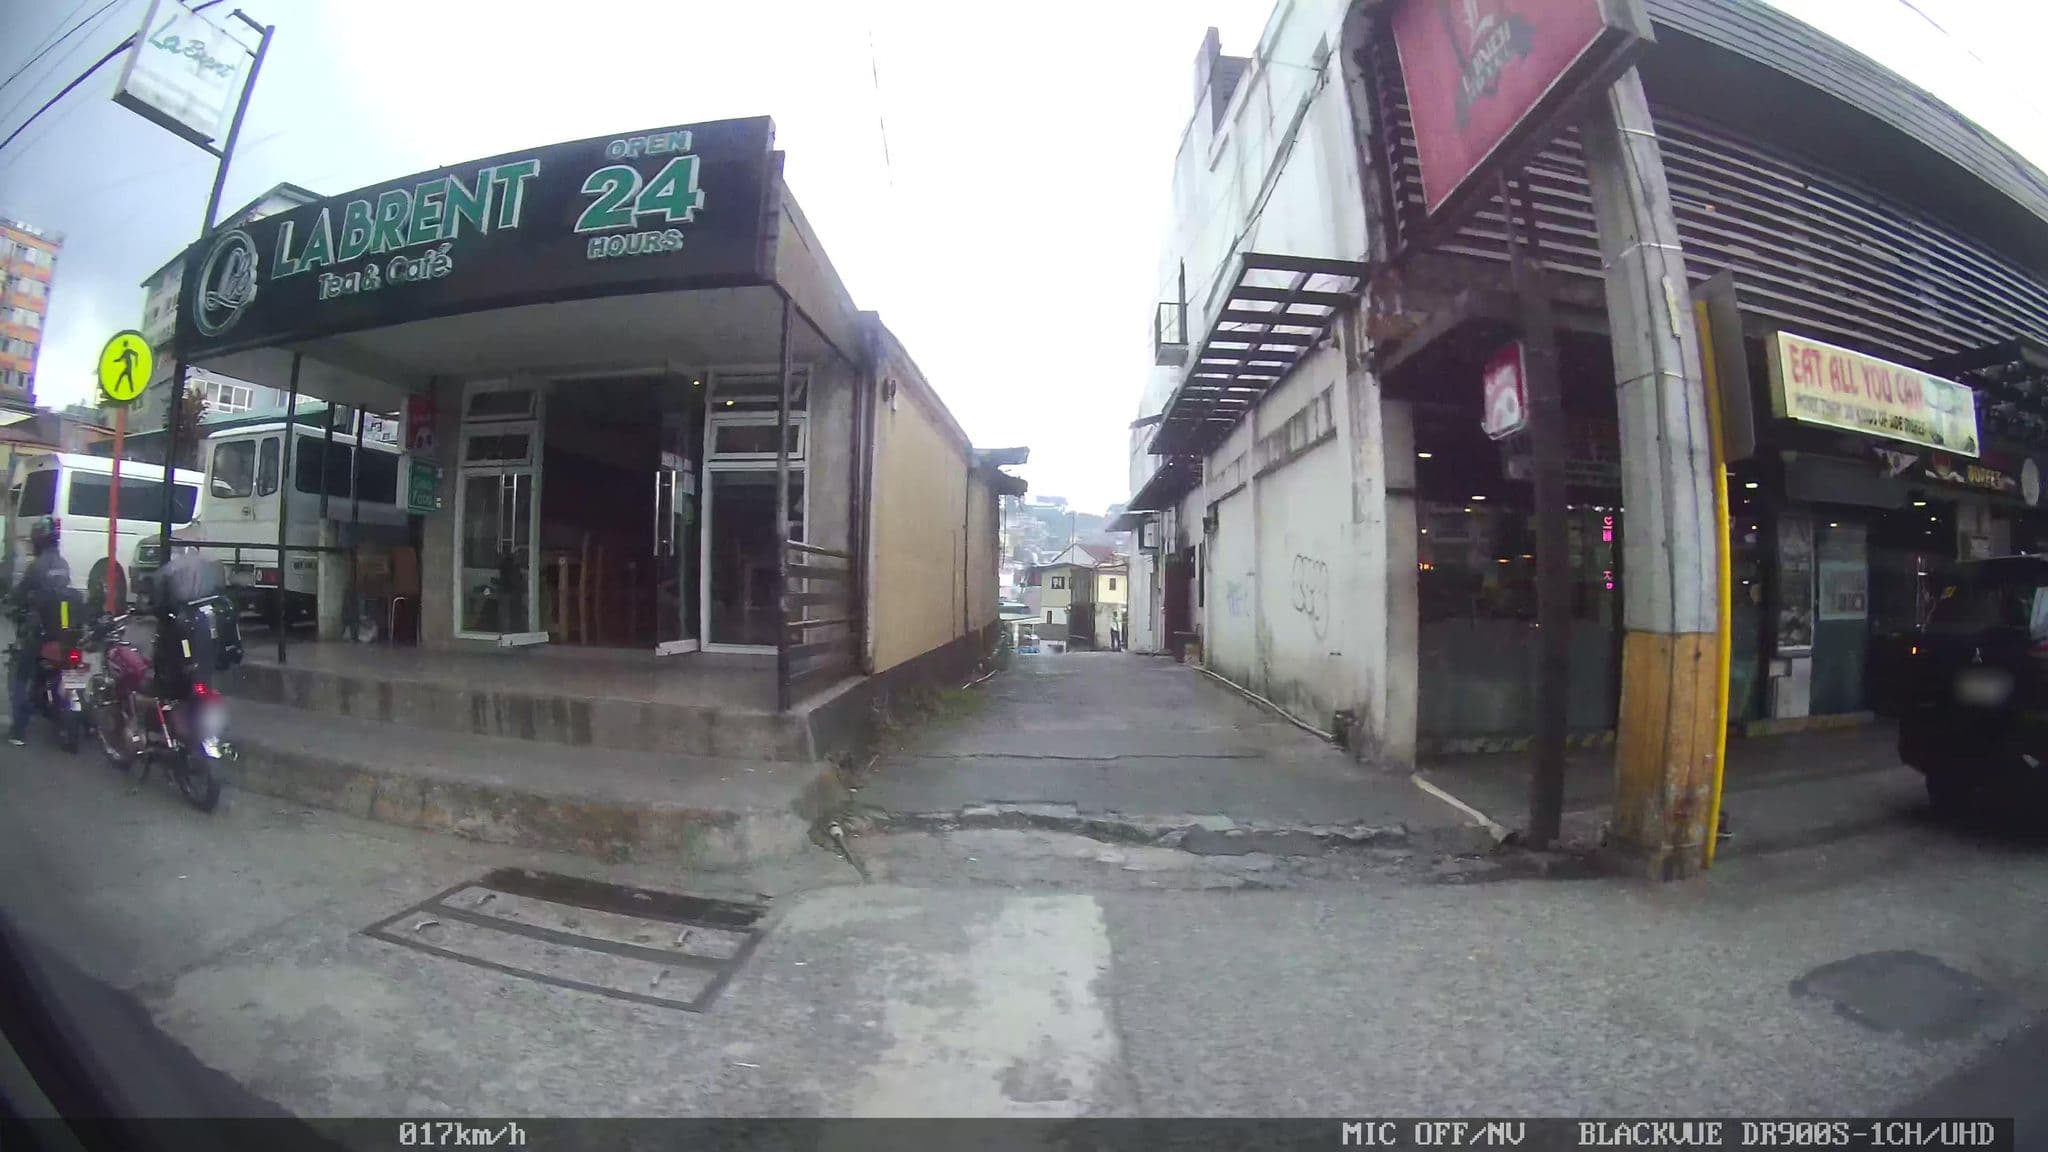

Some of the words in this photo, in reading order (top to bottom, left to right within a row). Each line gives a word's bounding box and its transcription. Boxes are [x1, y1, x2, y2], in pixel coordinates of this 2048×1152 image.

[606, 130, 692, 160] OPEN
[271, 158, 541, 280] LABRENT
[574, 154, 705, 233] 24
[319, 272, 361, 300] Tea
[362, 263, 382, 290] &
[385, 242, 453, 286] Café
[587, 228, 684, 259] HOURS
[1788, 343, 1823, 388] EAT
[1829, 355, 1859, 396] ALL
[1861, 362, 1893, 403] YOU
[1895, 371, 1924, 410] CAN
